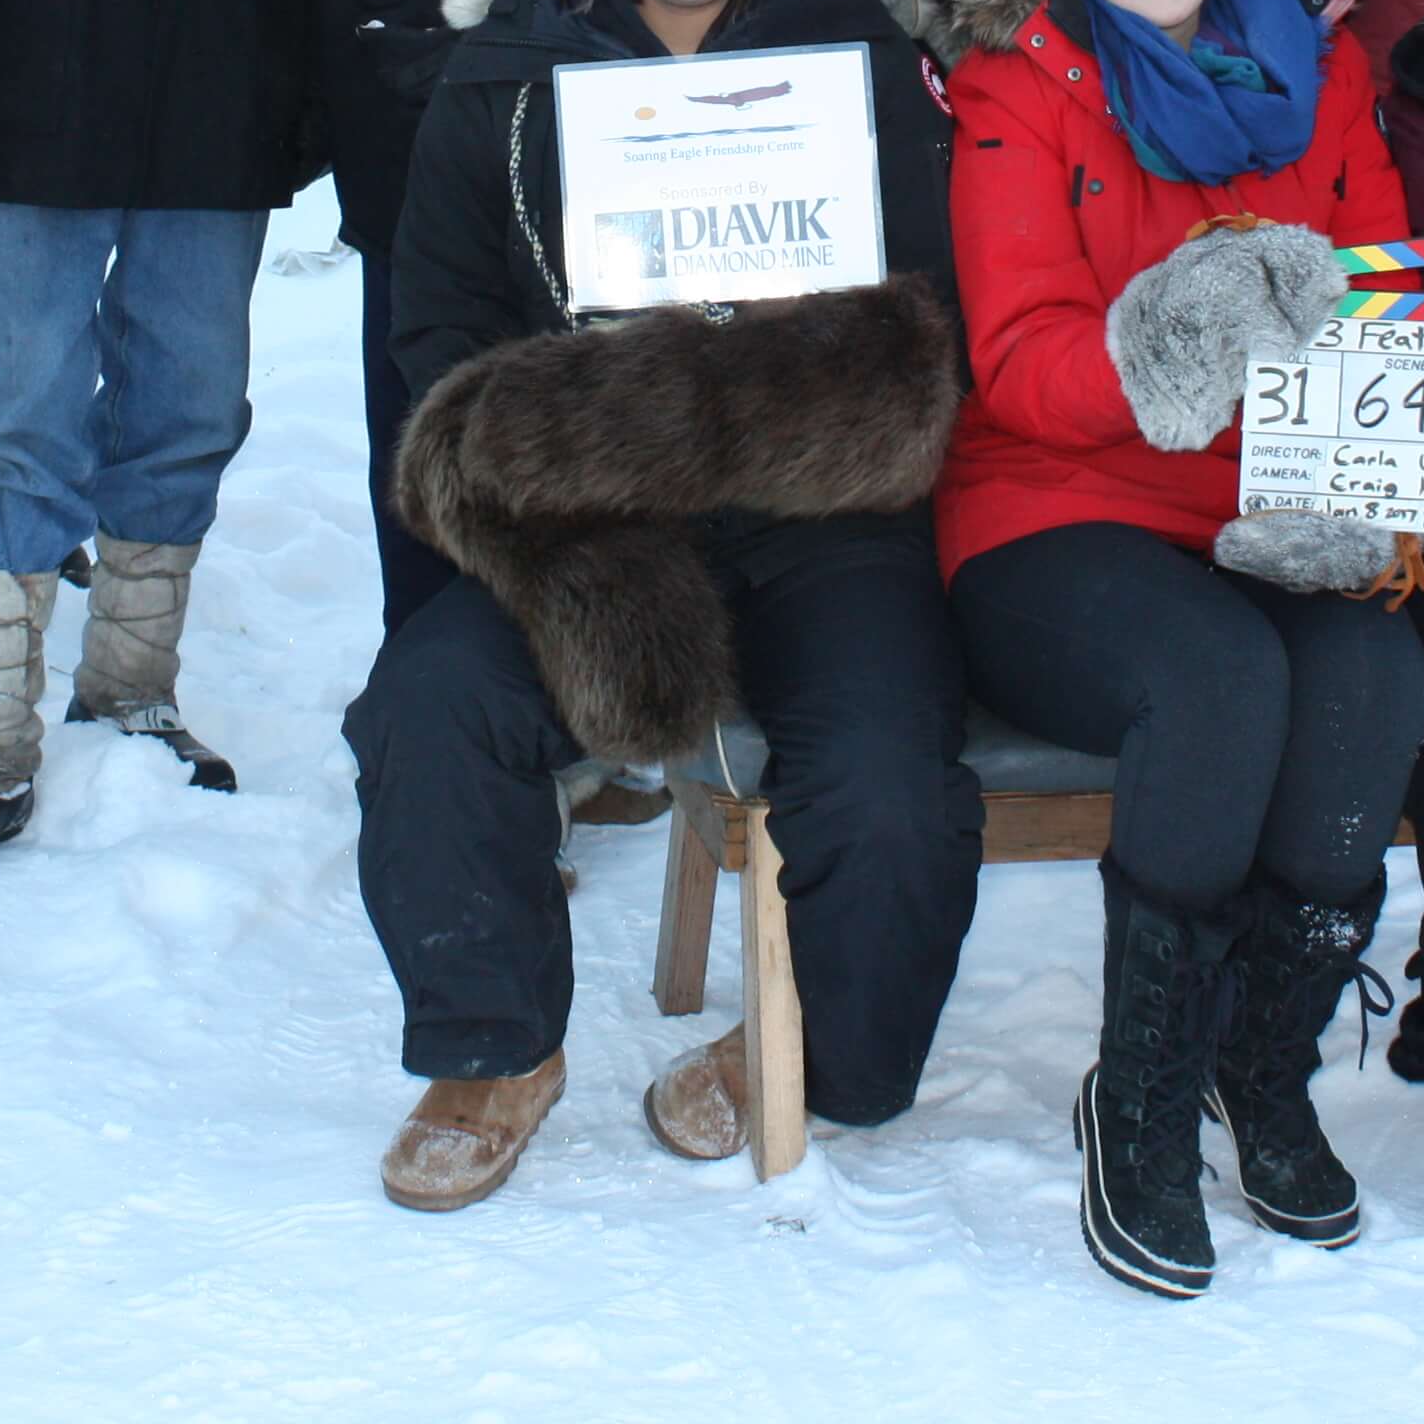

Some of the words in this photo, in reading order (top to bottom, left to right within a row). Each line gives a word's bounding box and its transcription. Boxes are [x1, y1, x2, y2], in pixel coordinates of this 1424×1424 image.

[623, 150, 667, 164] Soaring
[670, 146, 702, 161] Eagle
[705, 142, 765, 158] Friendship
[767, 140, 806, 153] Centre
[658, 181, 743, 202] Sponsored
[748, 180, 769, 197] By
[670, 197, 833, 251] DIAVIK
[673, 249, 776, 277] DIAMOND
[782, 244, 835, 269] MINE
[1314, 319, 1344, 348] 3
[1282, 352, 1313, 365] OLL
[1256, 366, 1309, 425] 31
[1251, 445, 1322, 461] DIRECTOR:
[1333, 444, 1398, 468] Carla
[1250, 466, 1312, 481] CAMERA:
[1329, 472, 1398, 498] Craig
[1274, 496, 1315, 509] DATE:
[1365, 501, 1380, 519] 8
